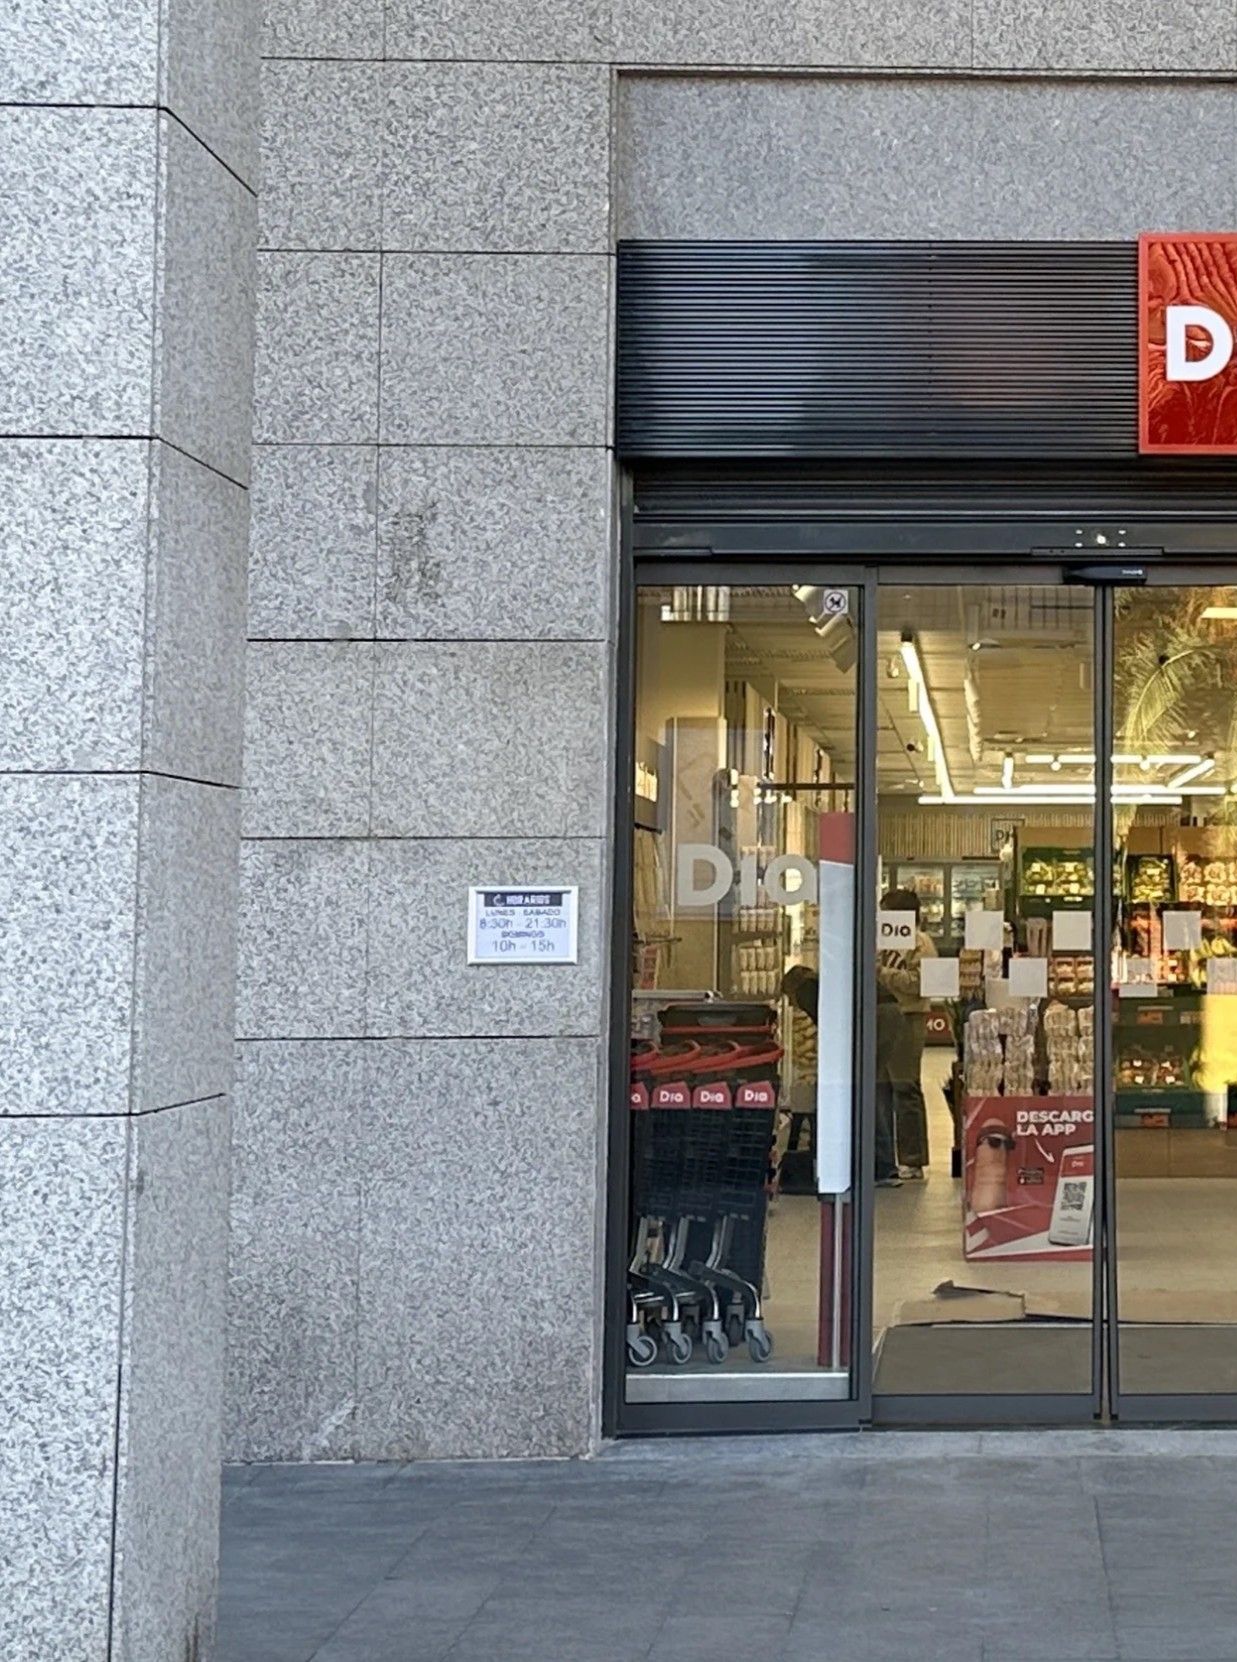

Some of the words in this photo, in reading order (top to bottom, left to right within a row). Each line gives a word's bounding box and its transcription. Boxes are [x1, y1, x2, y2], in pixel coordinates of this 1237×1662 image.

[677, 843, 818, 906] Dia
[881, 923, 911, 937] Dia
[659, 1091, 684, 1103] Dia
[700, 1091, 724, 1103] Dia
[744, 1089, 768, 1102] Dia
[1016, 1124, 1039, 1136] LA
[1042, 1124, 1077, 1136] APP
